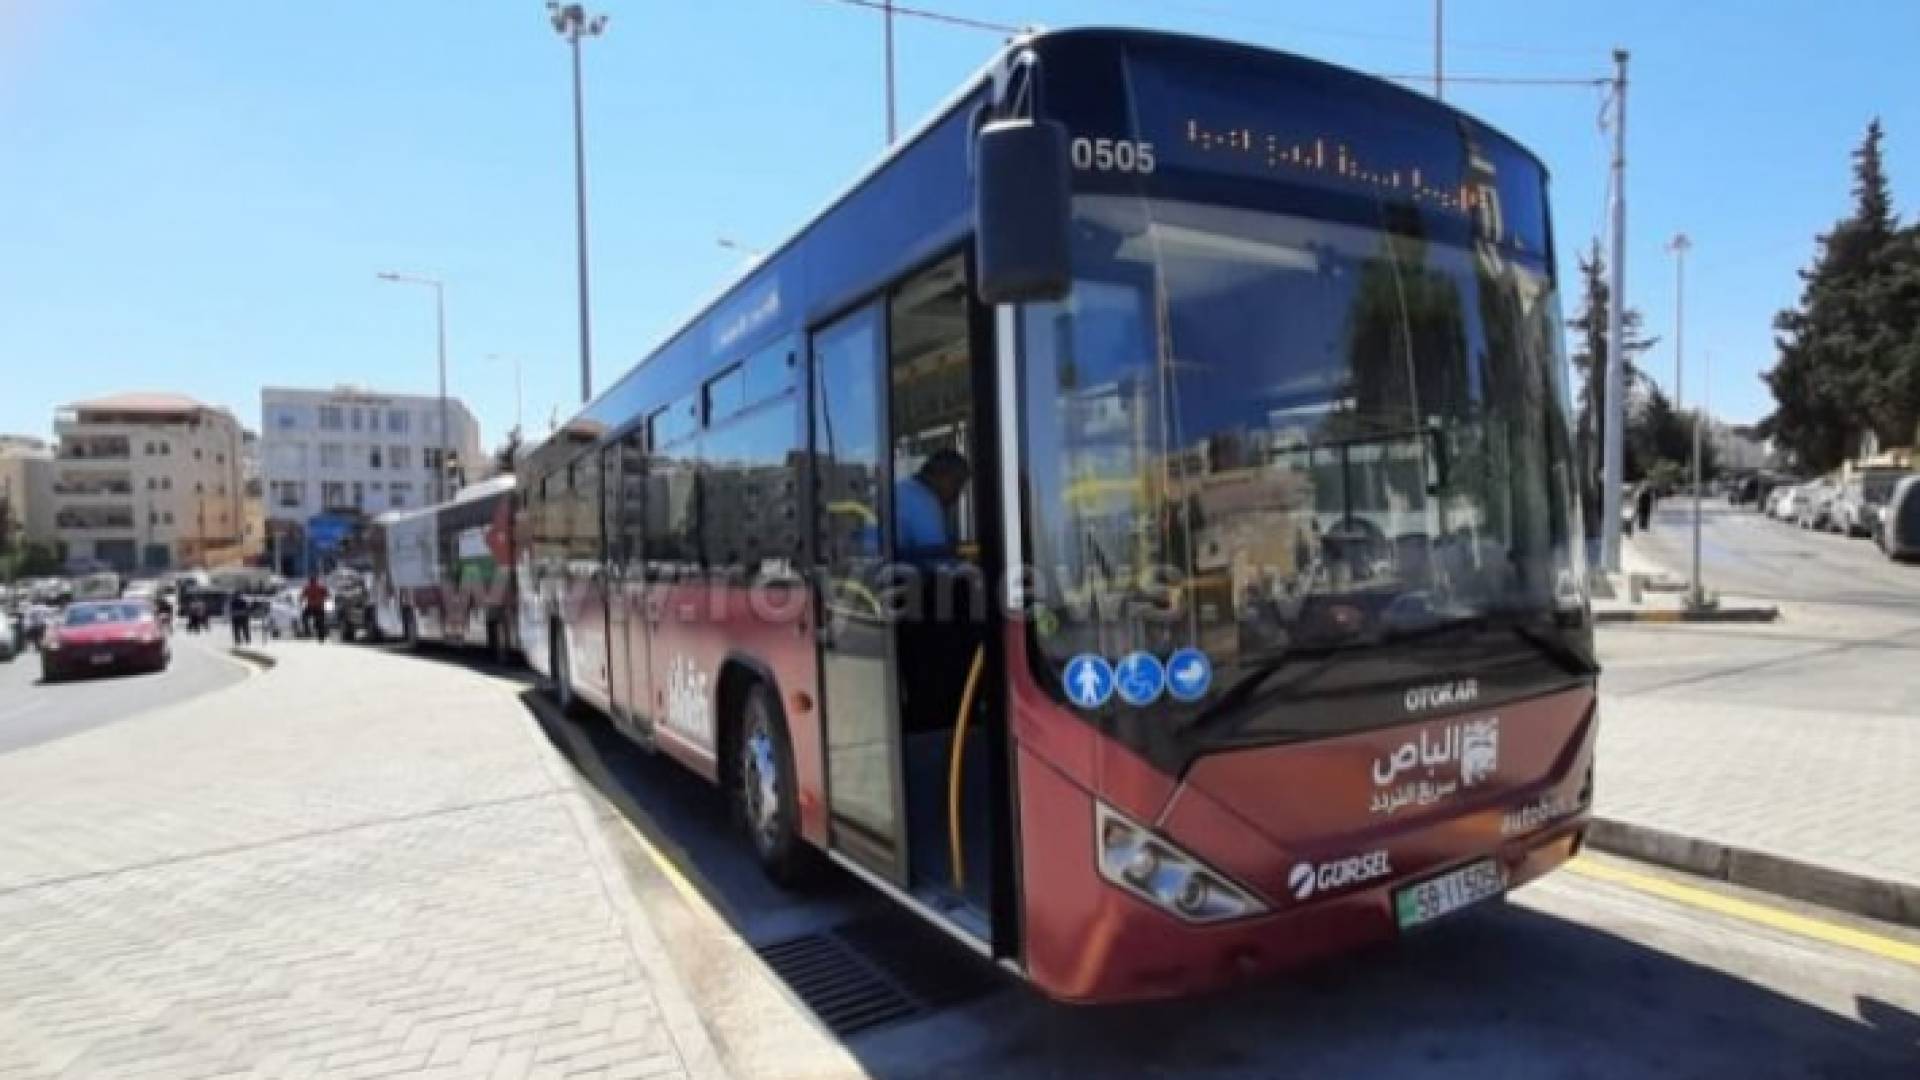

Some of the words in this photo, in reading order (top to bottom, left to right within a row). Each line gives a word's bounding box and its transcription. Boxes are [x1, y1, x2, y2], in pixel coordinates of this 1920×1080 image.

[1071, 137, 1155, 174] 0505
[1404, 678, 1478, 712] OTOKAR
[1373, 725, 1459, 785] الباص
